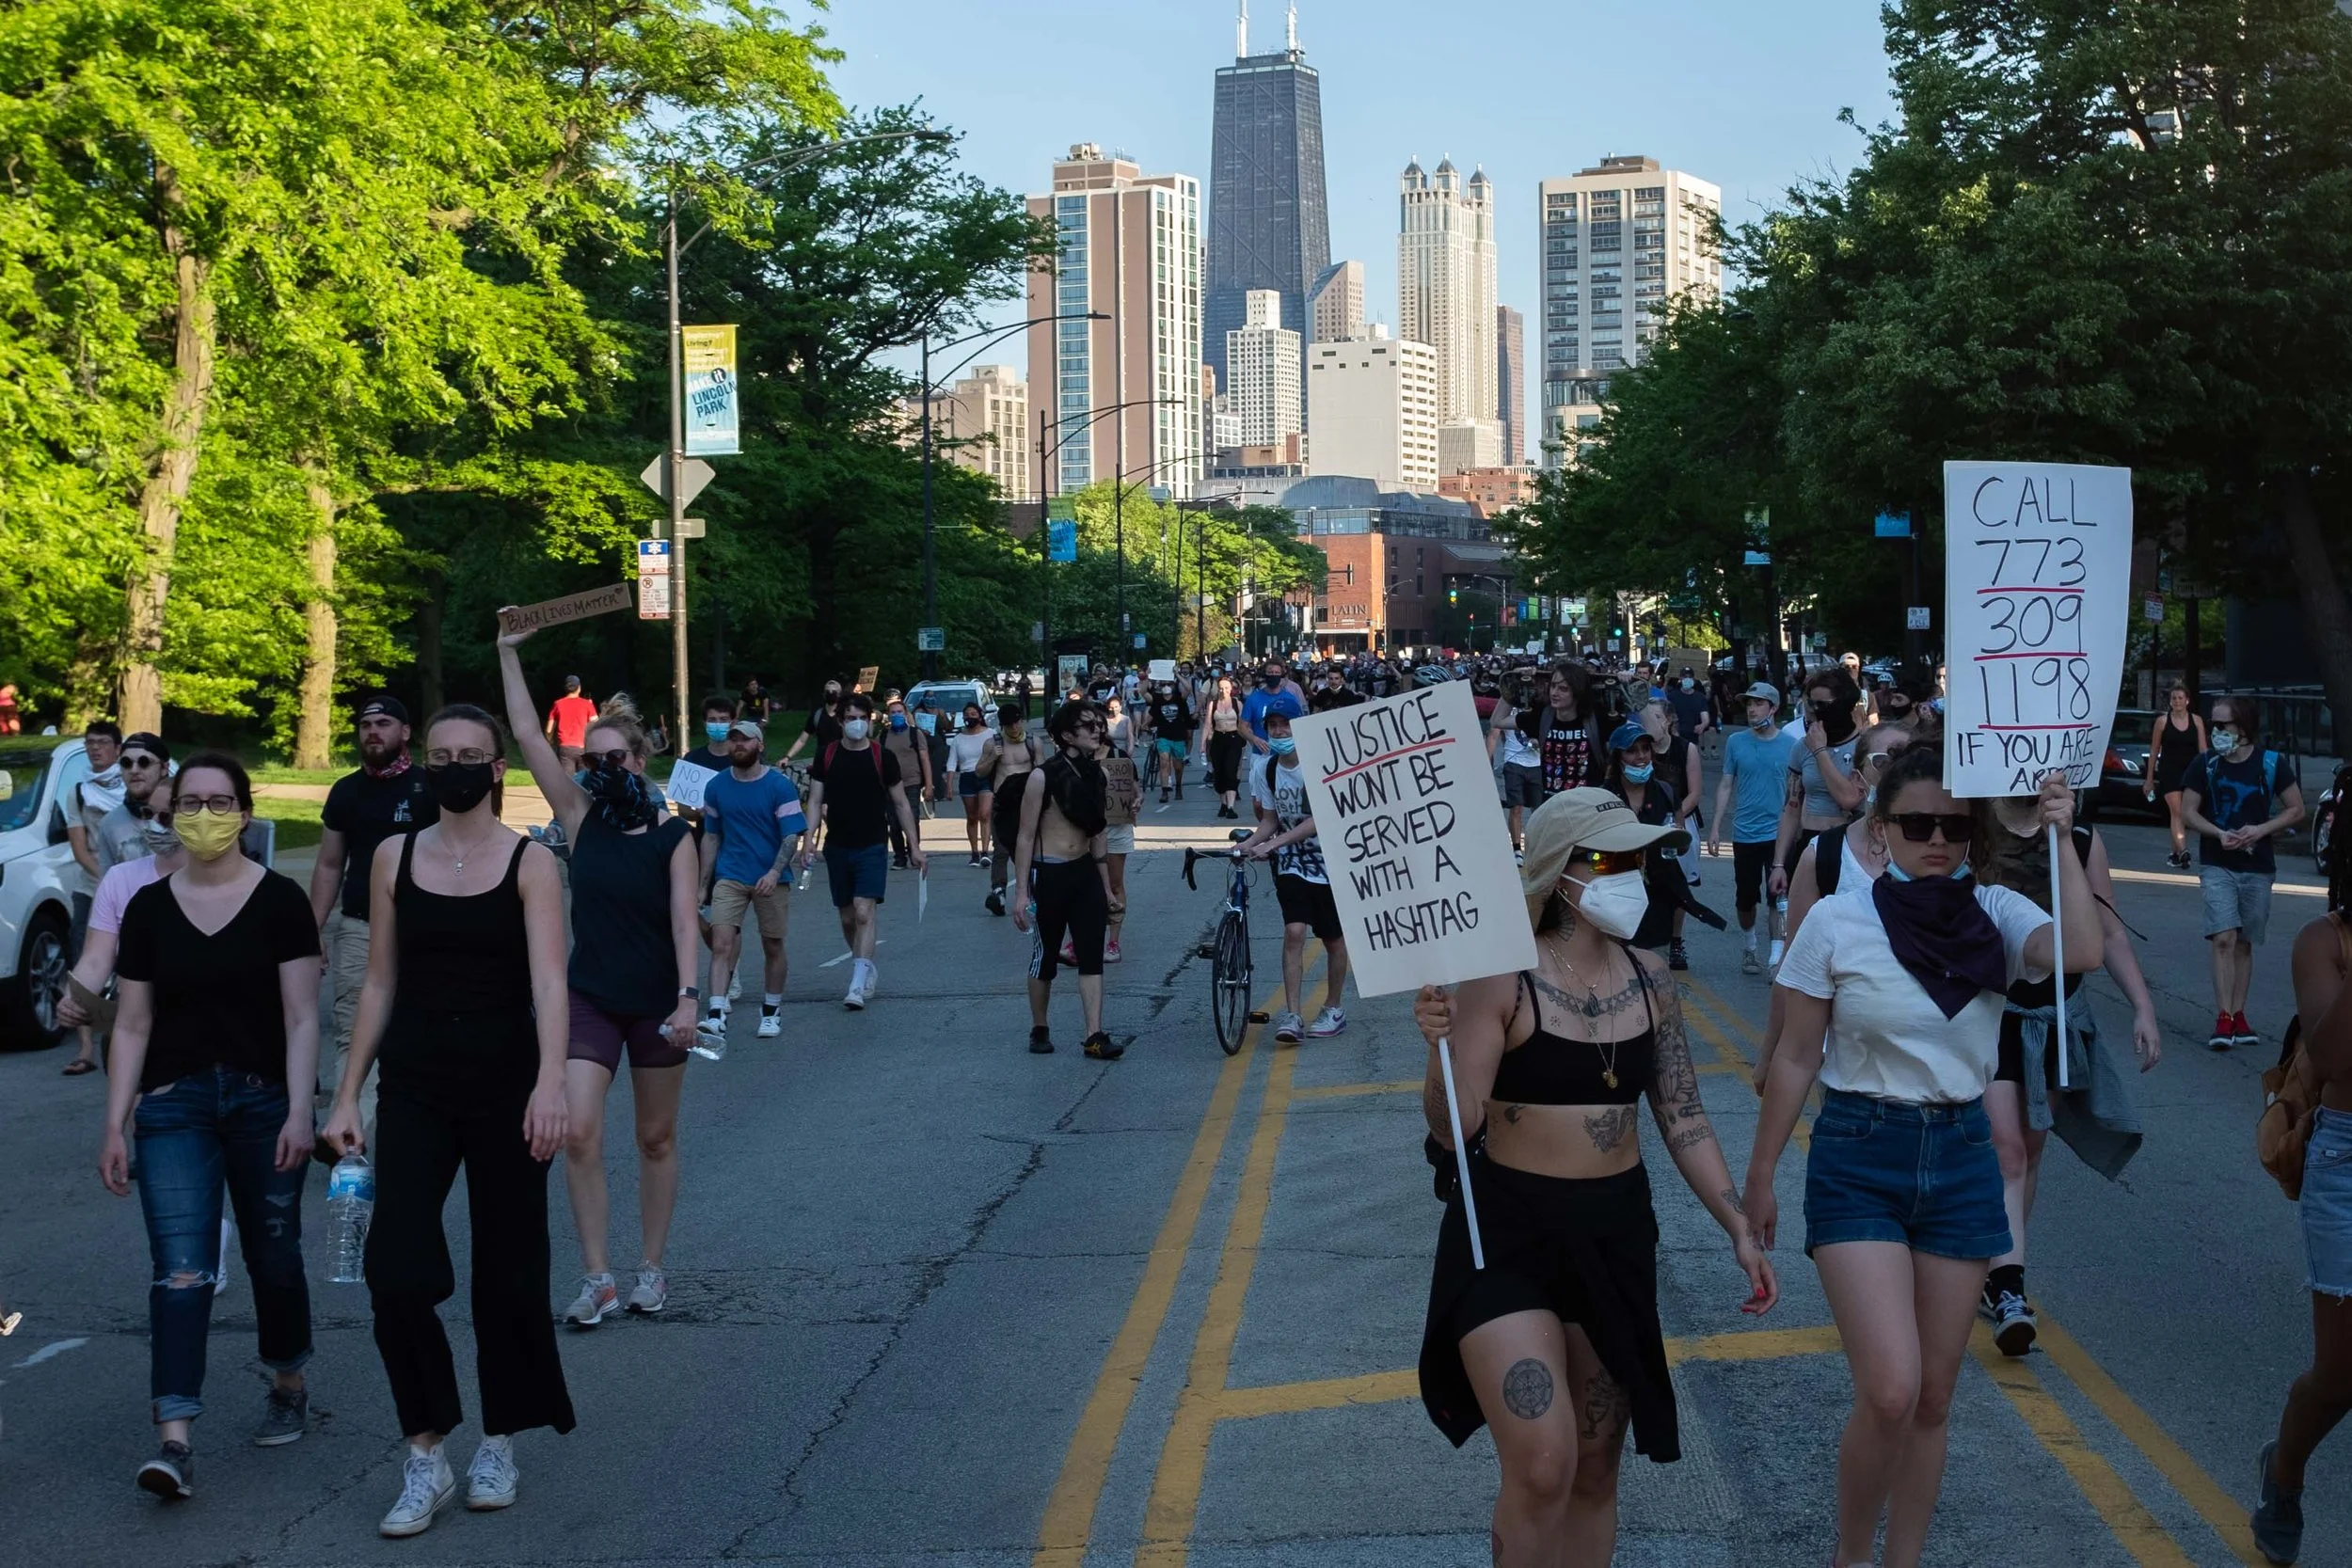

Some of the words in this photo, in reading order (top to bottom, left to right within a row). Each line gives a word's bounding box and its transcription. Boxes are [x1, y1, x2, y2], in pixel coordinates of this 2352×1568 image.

[691, 380, 737, 404] LINCOLN
[713, 369, 724, 383] it
[696, 398, 727, 418] PARK
[1972, 476, 2097, 528] CALL
[1974, 537, 2086, 587] 773
[507, 610, 543, 632] BLACK
[542, 603, 571, 623] LIVES
[1331, 604, 1367, 616] LATIN
[1979, 594, 2083, 655] 309
[1979, 657, 2090, 725] 1198
[1322, 689, 1446, 775] JUSTICE
[1956, 732, 1984, 767] IF
[1994, 732, 2051, 768] YOU
[2059, 725, 2101, 761] ARE
[672, 783, 700, 803] NO
[677, 765, 701, 784] NO
[1408, 748, 1454, 797] BE
[2010, 763, 2093, 792] ARTED
[1344, 800, 1455, 863] SERVED
[1349, 856, 1414, 901] WITH
[1435, 845, 1462, 882] A
[1364, 891, 1479, 952] HASHTAG
